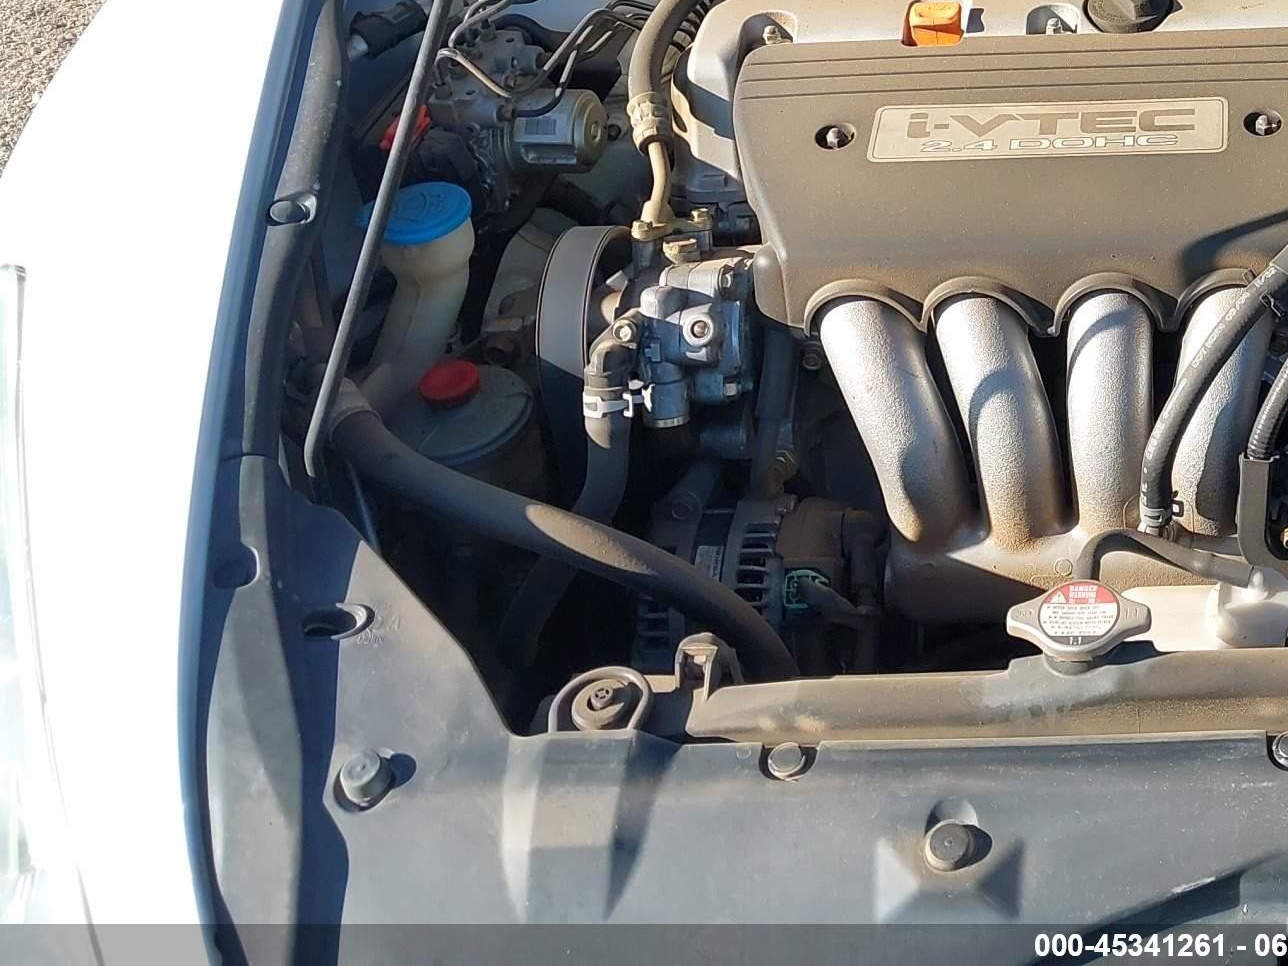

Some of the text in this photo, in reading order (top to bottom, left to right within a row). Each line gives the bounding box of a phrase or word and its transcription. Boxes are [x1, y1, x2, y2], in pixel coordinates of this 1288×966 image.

[907, 108, 1196, 139] i-VTEC
[920, 134, 1179, 153] 2.4 DOHC
[1069, 636, 1082, 645] 1.1
